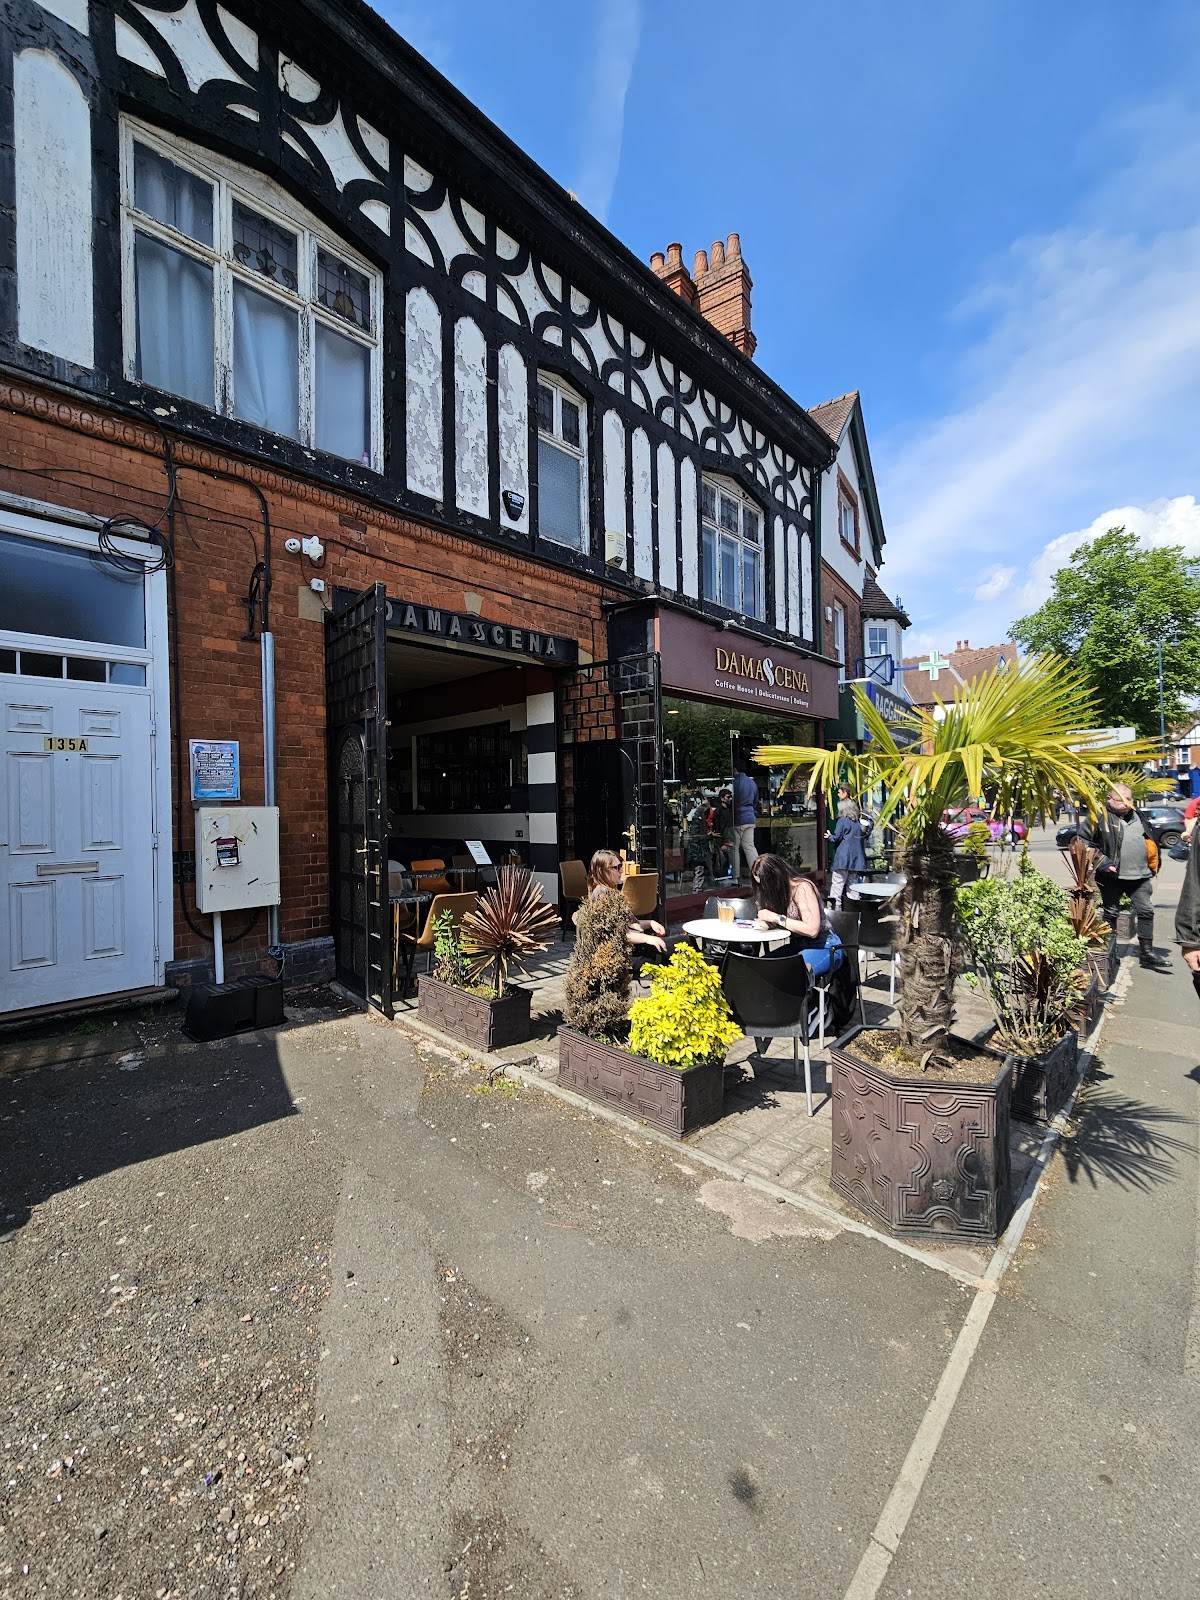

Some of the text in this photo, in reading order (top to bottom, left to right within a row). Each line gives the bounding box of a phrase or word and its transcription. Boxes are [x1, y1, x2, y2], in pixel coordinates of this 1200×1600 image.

[715, 648, 810, 692] DAMASCENA
[715, 679, 809, 708] Coffee House Delicatessen Bakery
[47, 737, 87, 751] 135A
